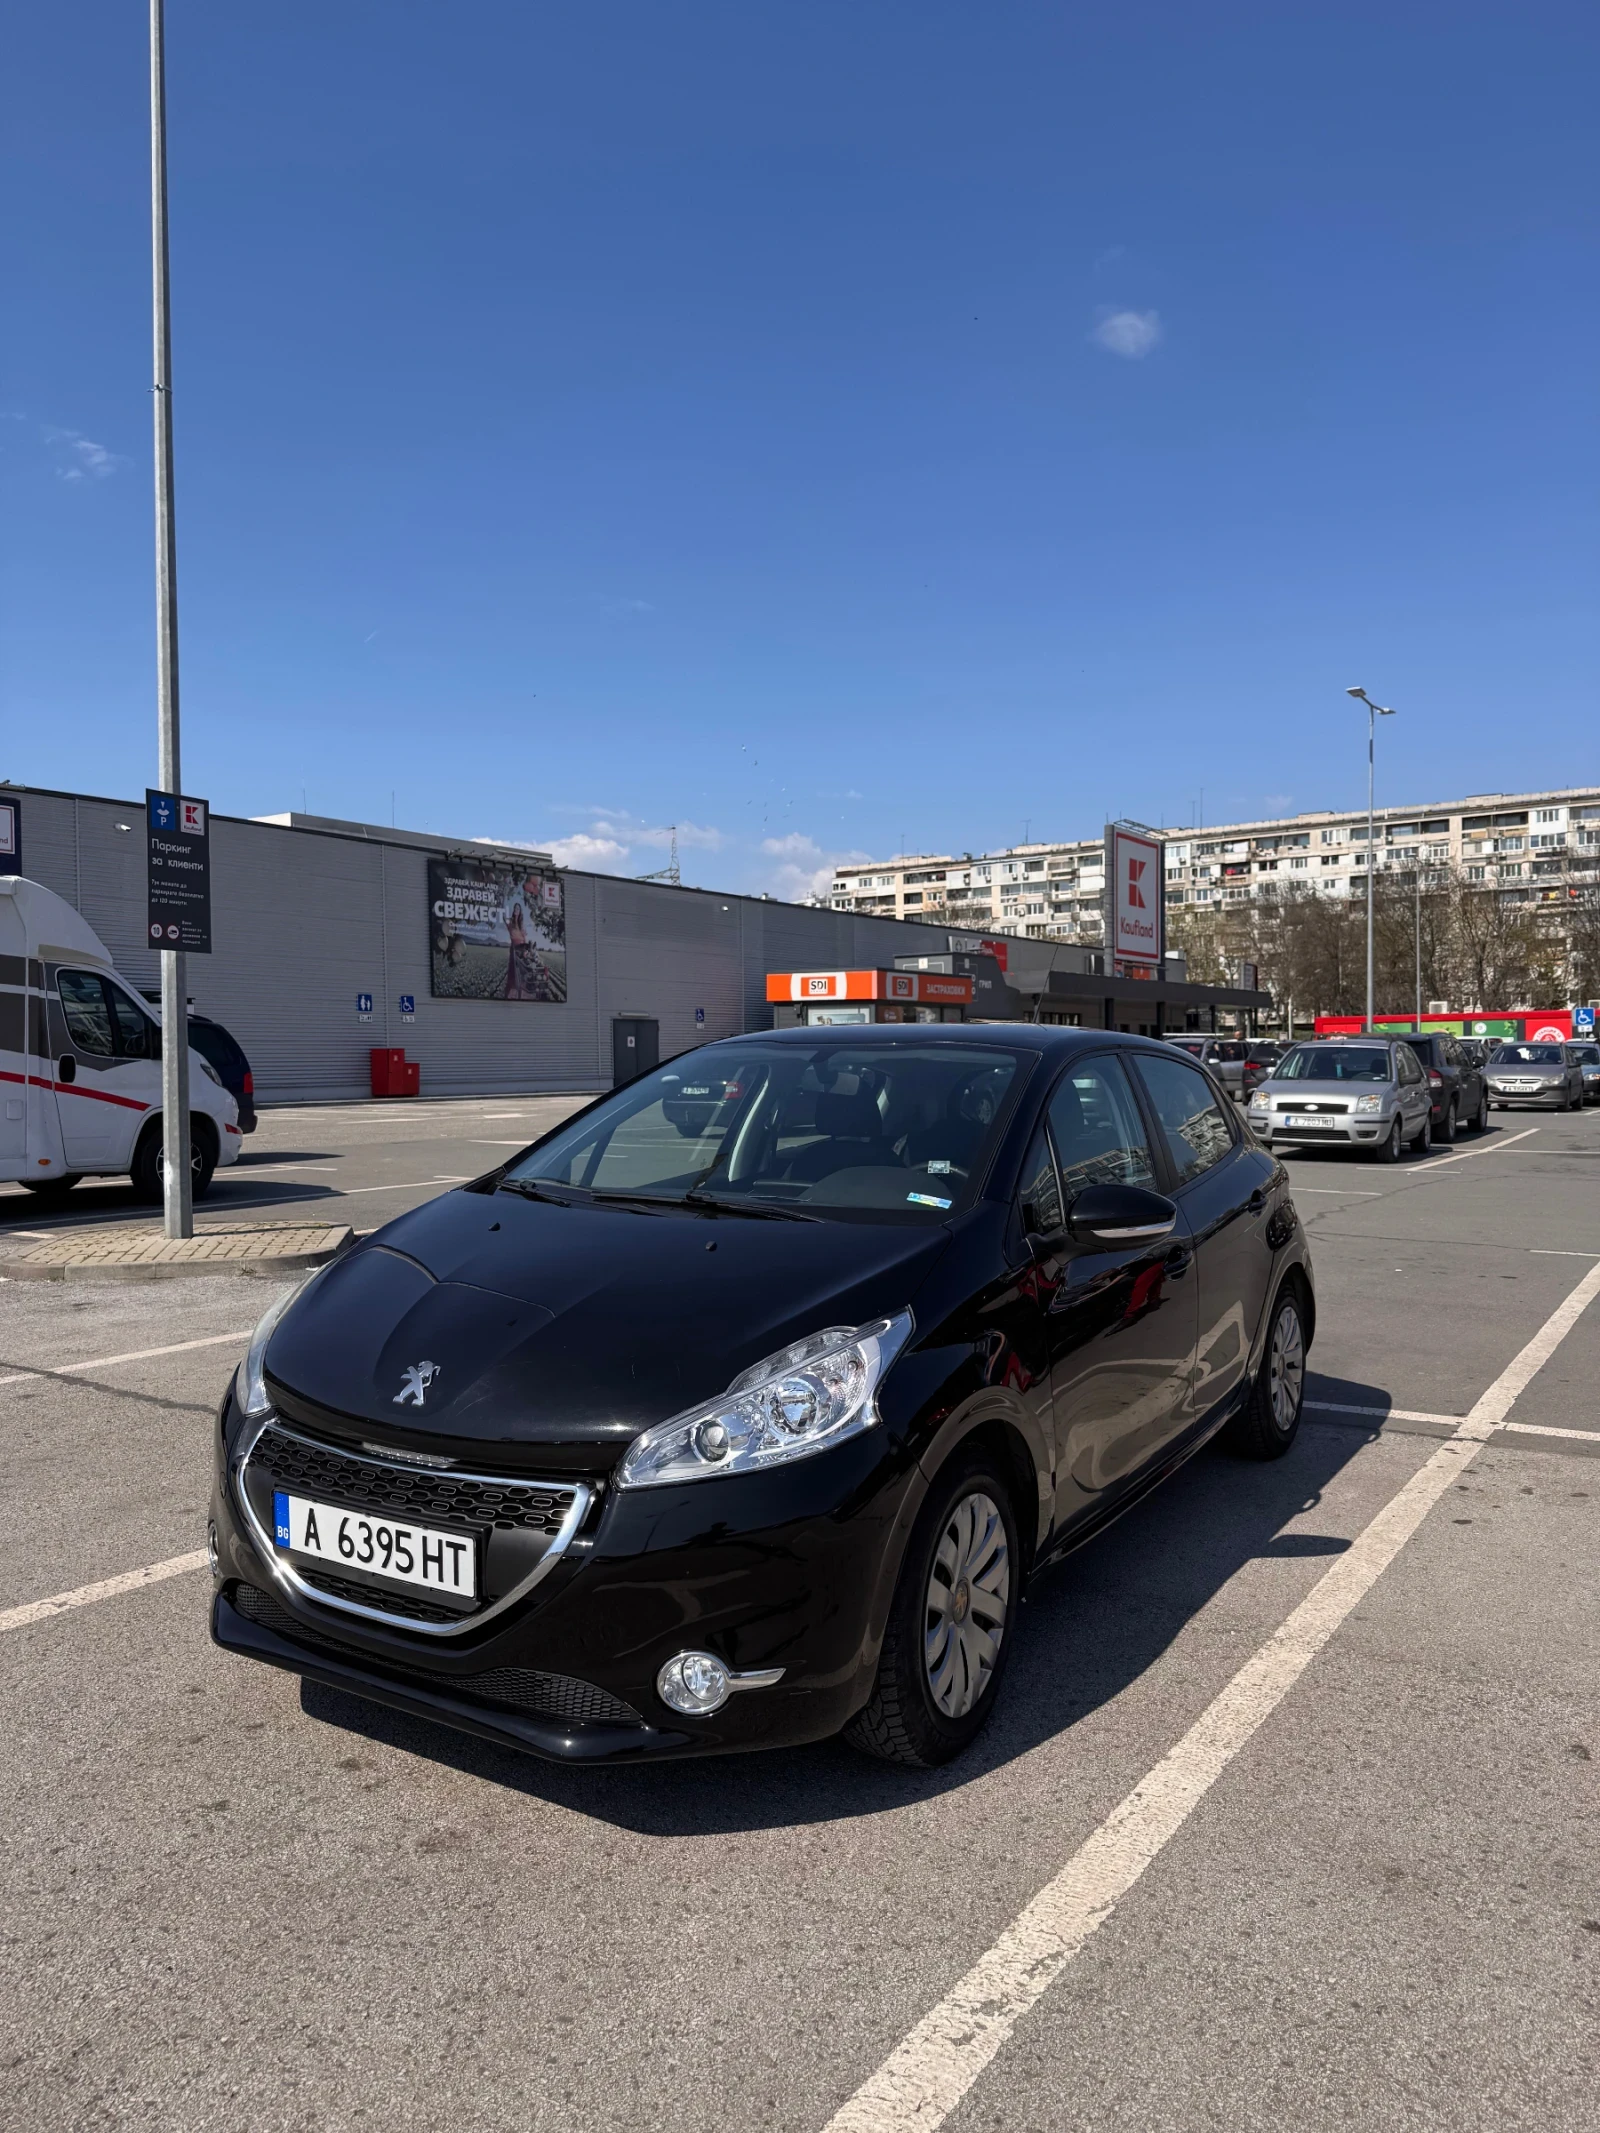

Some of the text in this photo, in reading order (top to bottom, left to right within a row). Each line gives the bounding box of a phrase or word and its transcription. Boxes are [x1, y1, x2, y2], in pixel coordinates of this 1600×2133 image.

[160, 816, 167, 826] P
[151, 838, 192, 854] Паркинг
[152, 857, 204, 871] за клиенти
[446, 887, 498, 905] ЗДРАВЕЙ,
[434, 900, 510, 924] СВЕЖЕСТ!
[1120, 916, 1154, 939] Kaufland
[810, 980, 827, 990] SDI
[896, 980, 908, 990] SDI
[926, 984, 966, 996] ЗАСТРАХОВКИ
[277, 1525, 289, 1540] BG
[304, 1507, 467, 1587] A 6395 HT
